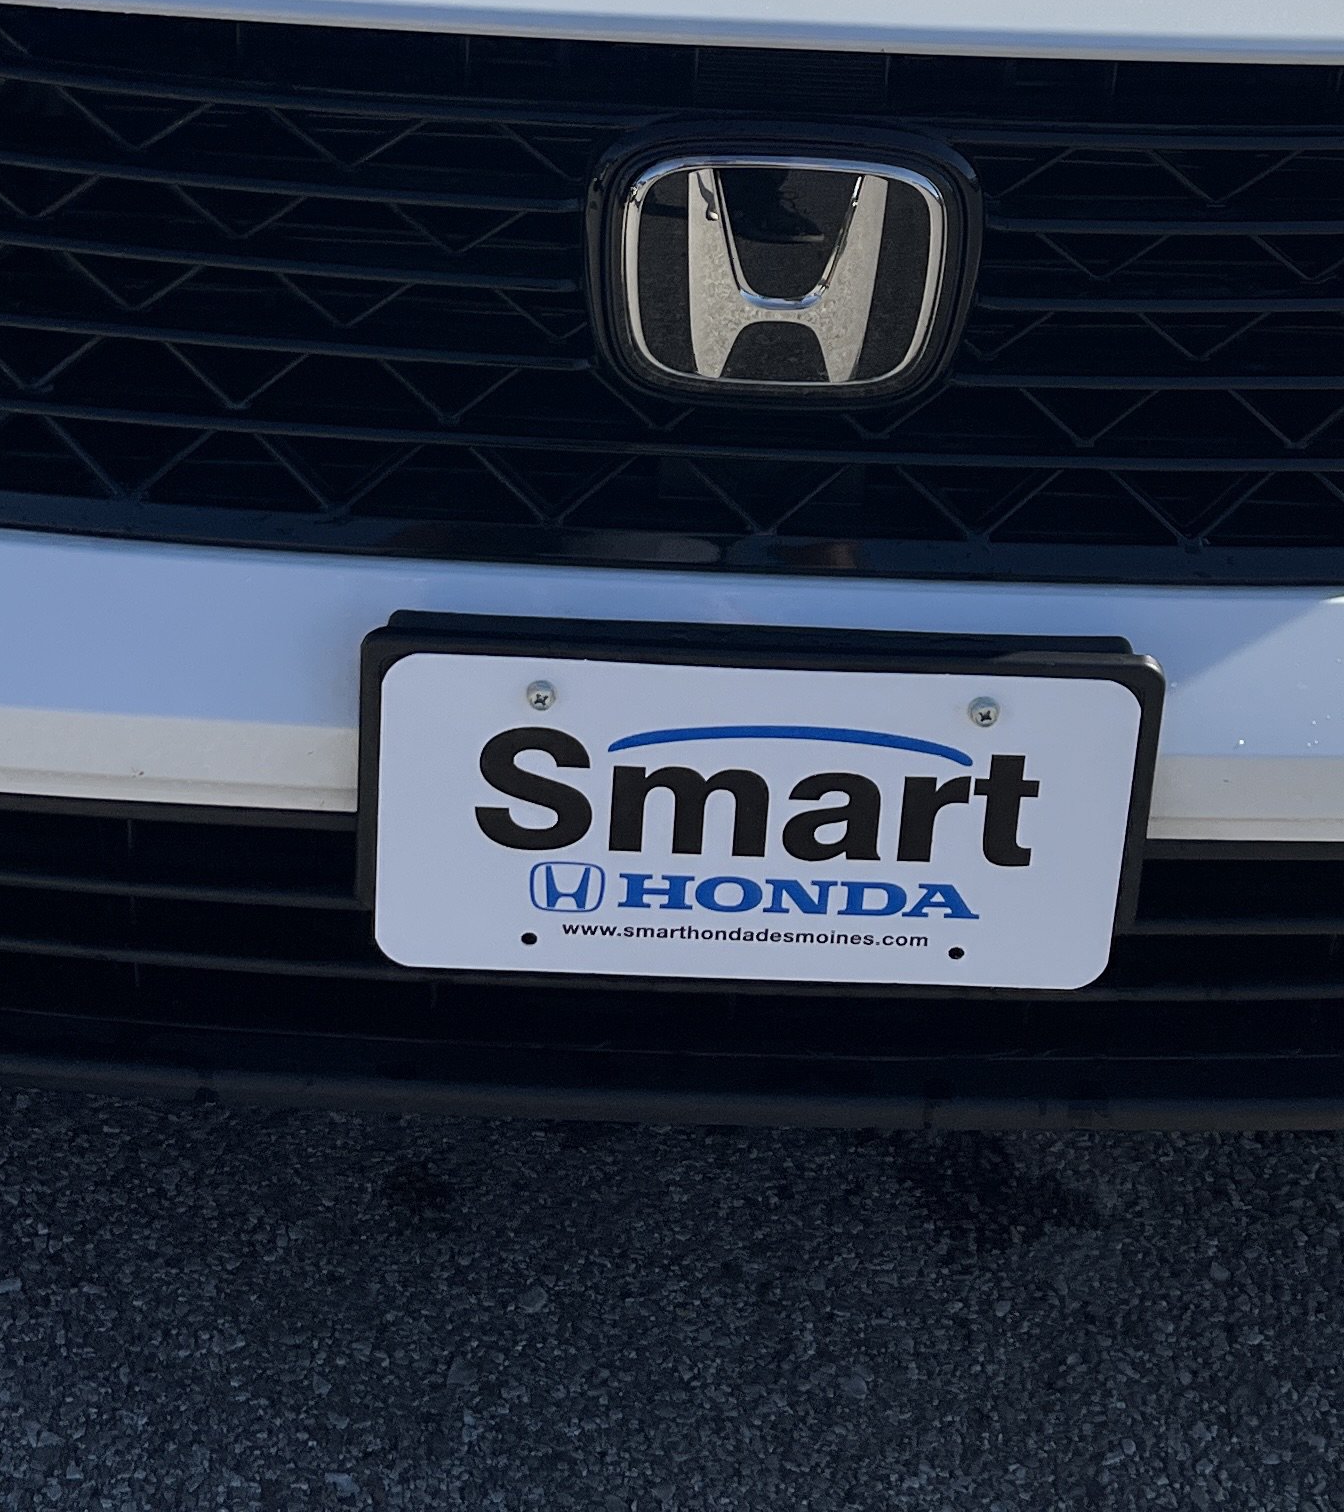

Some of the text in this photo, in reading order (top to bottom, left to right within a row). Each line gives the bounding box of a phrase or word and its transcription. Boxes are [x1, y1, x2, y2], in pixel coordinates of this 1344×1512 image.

[474, 726, 1040, 867] Smart
[617, 872, 980, 920] HONDA
[562, 921, 929, 948] www.smarthondadesmoines.com
